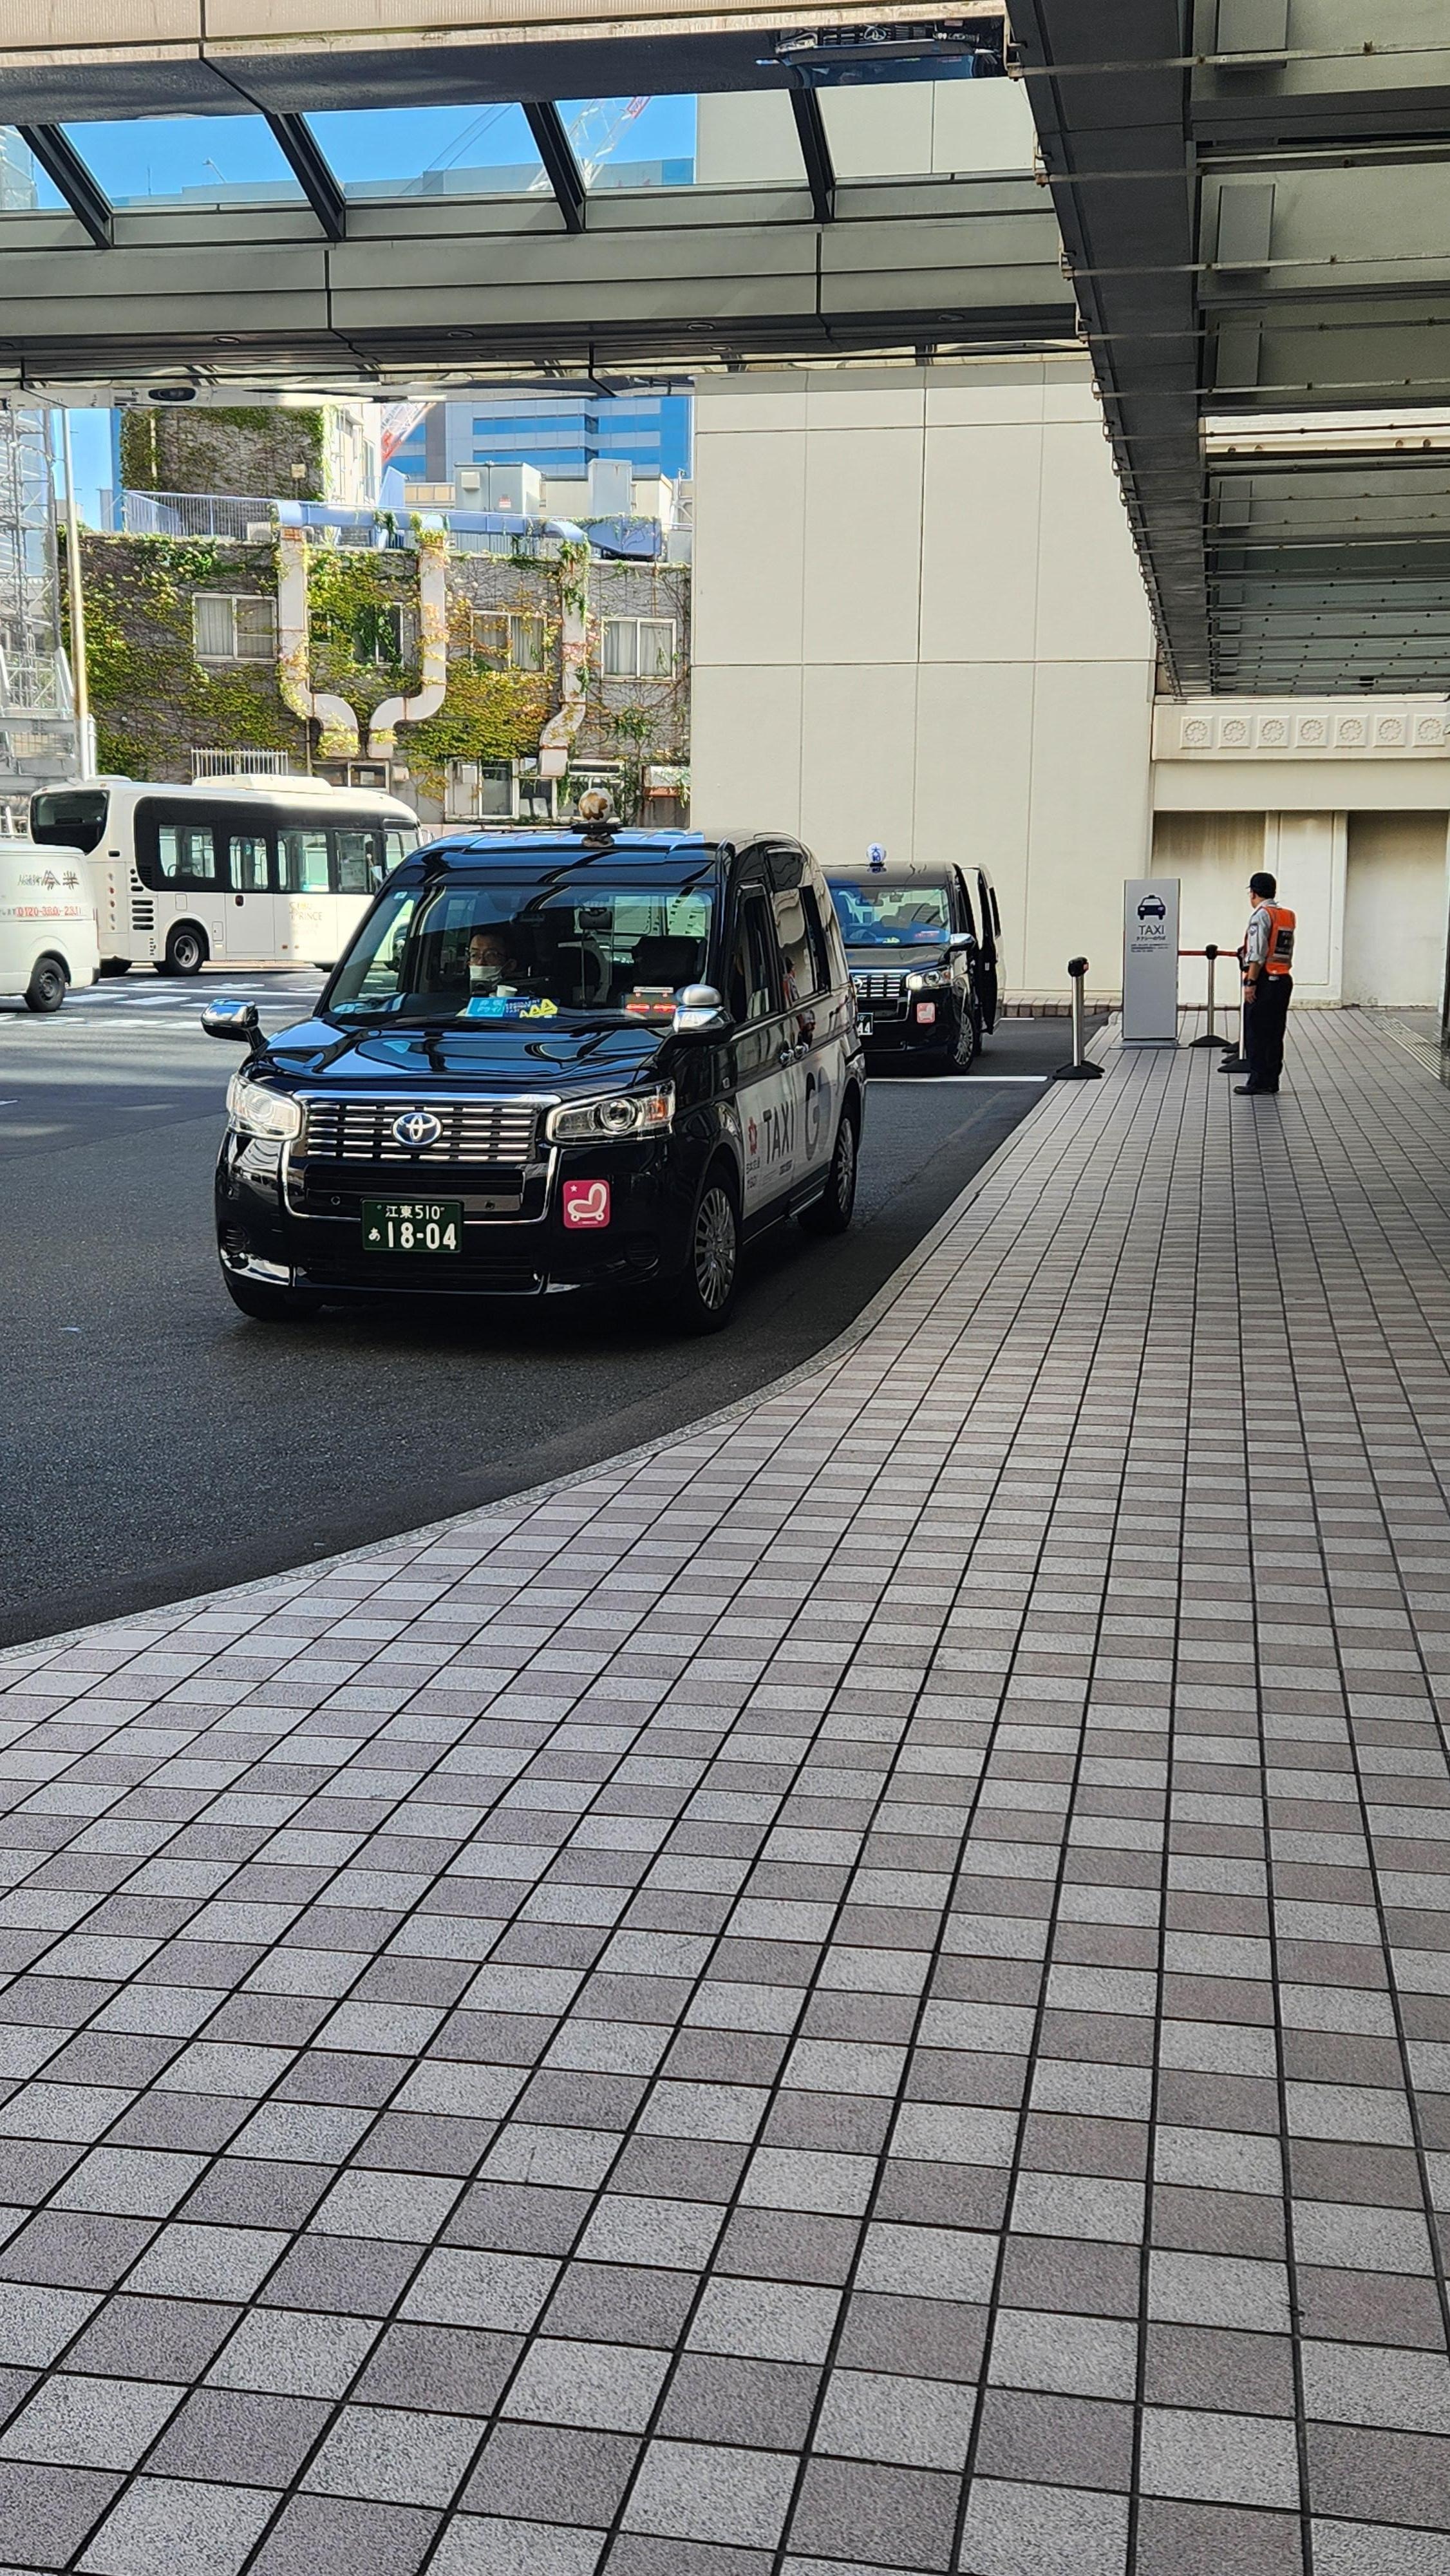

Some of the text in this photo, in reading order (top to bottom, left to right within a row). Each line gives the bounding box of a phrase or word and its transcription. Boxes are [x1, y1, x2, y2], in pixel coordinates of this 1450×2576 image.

[1138, 925, 1164, 935] TAXI
[762, 1099, 795, 1164] TAXI
[368, 1221, 457, 1250] あ 18-04
